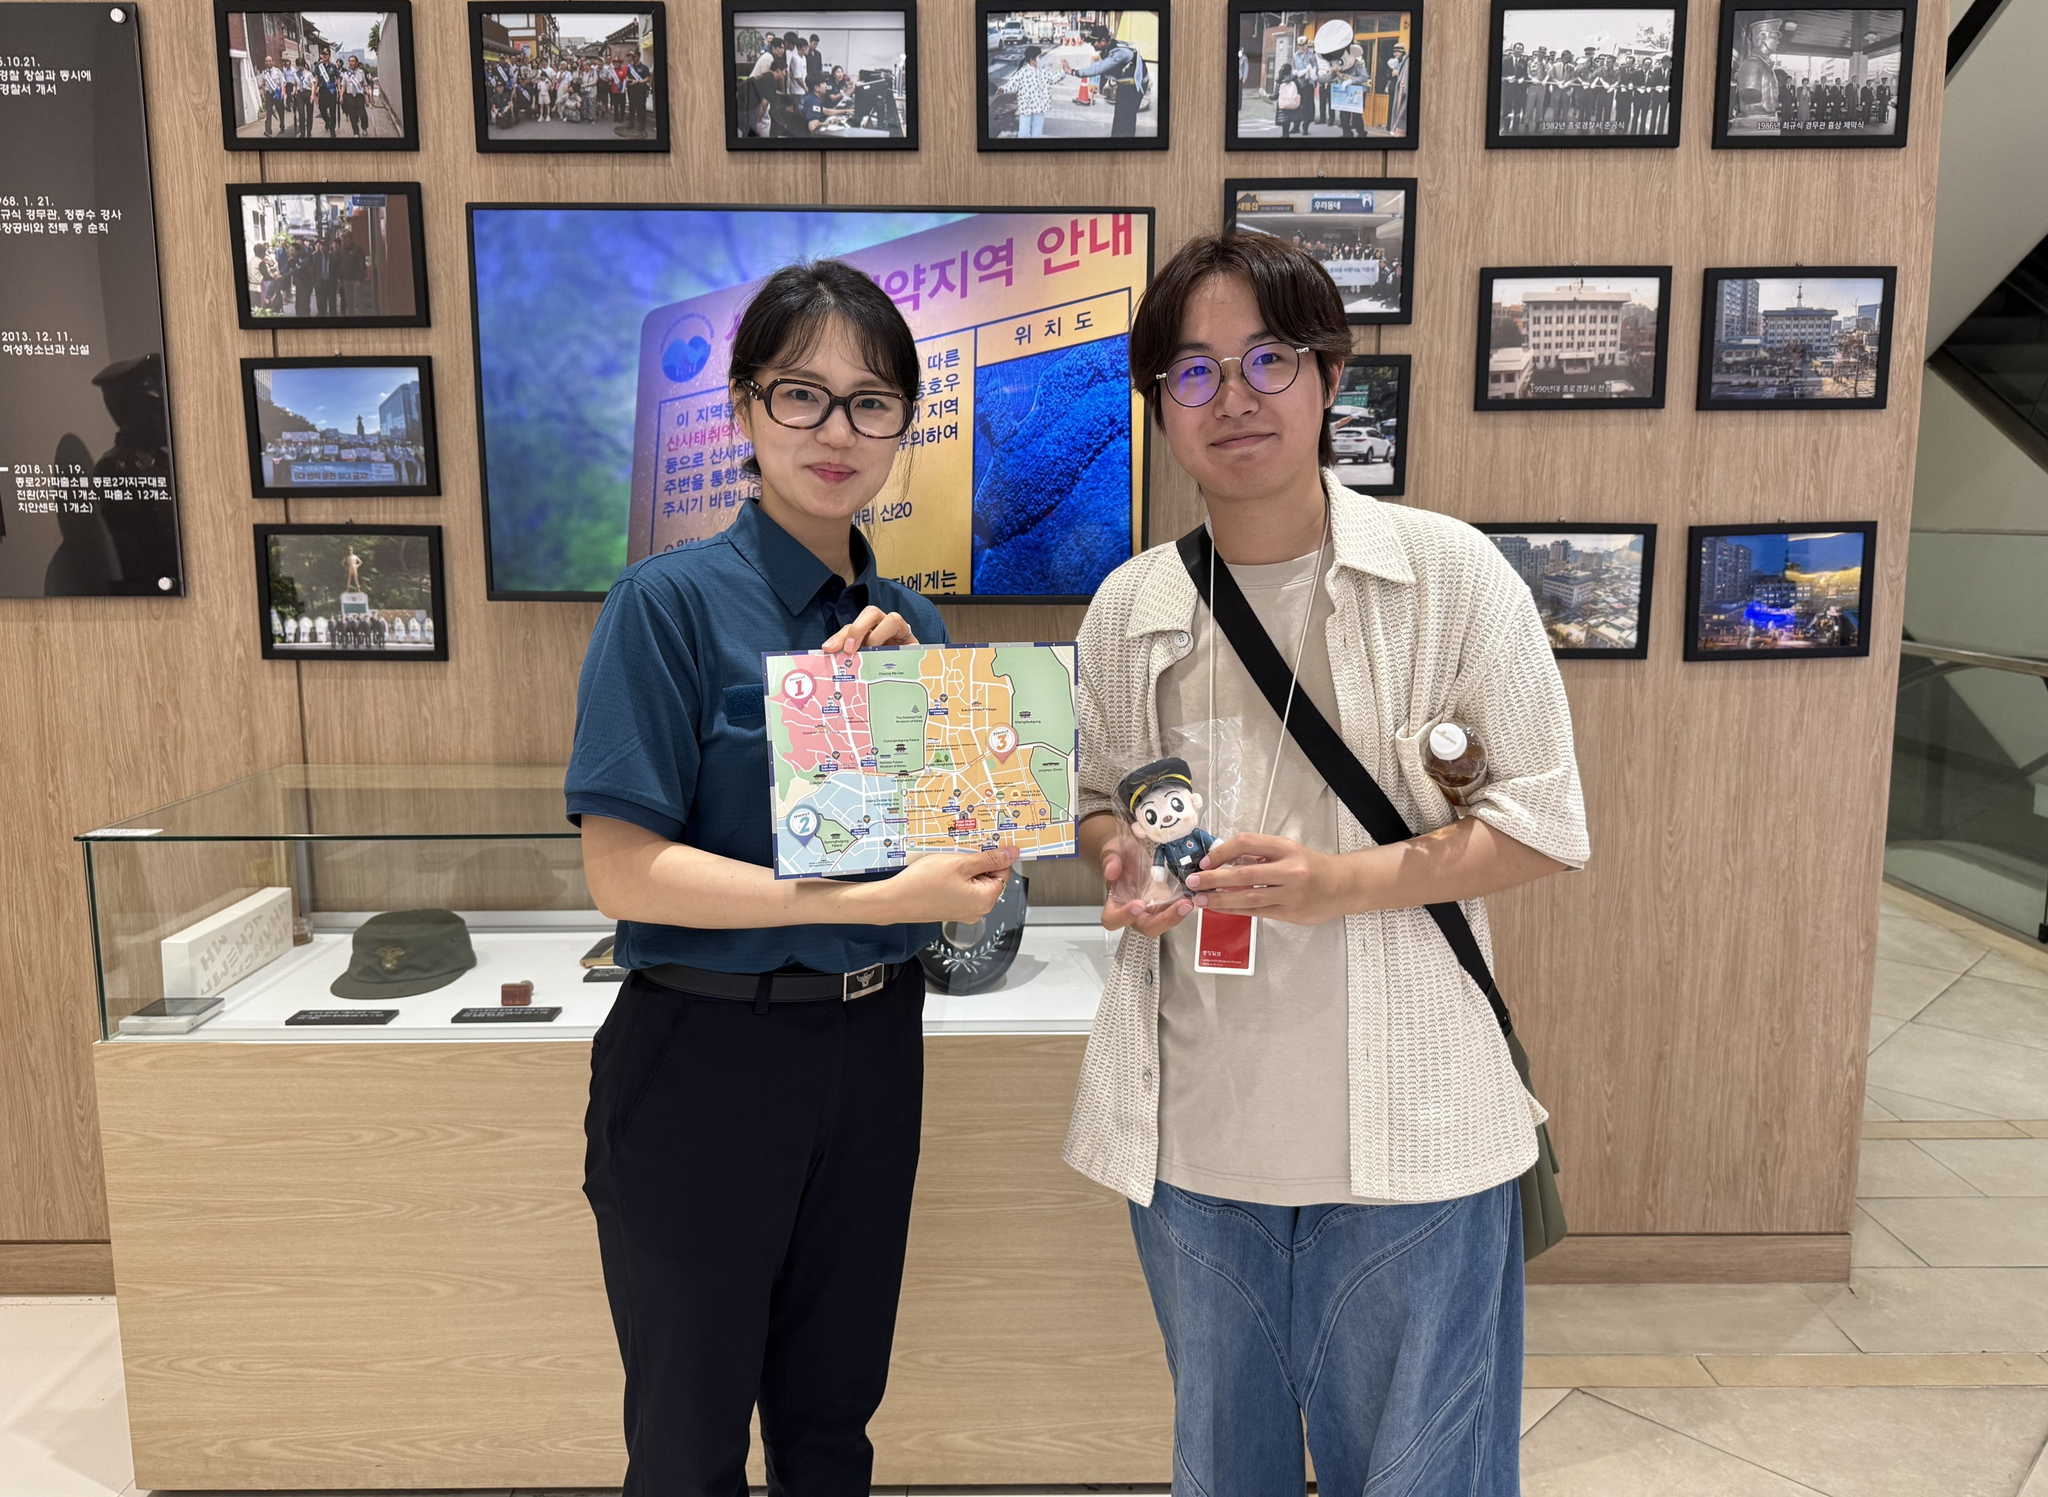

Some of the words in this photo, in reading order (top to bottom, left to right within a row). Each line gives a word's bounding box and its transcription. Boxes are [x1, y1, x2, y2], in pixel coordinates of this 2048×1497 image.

[24, 70, 56, 82] 창설과
[60, 70, 92, 82] 동시에
[36, 84, 57, 95] 개서
[1542, 121, 1565, 130] 1982년
[1568, 121, 1602, 130] 종로경찰서
[1604, 121, 1625, 129] 준공식
[1758, 122, 1780, 130] 1986년
[1782, 122, 1803, 130] 최규식
[1806, 122, 1826, 130] 경무관
[1844, 121, 1864, 129] 제막식
[0, 196, 19, 206] 68.
[24, 196, 33, 206] 1.
[38, 196, 54, 206] 21.
[1314, 201, 1341, 210] 우리동네
[1, 209, 21, 220] 규식
[26, 209, 60, 221] 경무관,
[65, 209, 96, 221] 정종수
[101, 209, 122, 221] 경사
[0, 222, 44, 234] 장공비와
[48, 222, 69, 234] 전투
[73, 222, 83, 234] 중
[88, 222, 108, 234] 순직
[875, 237, 1014, 311] 약지역
[1037, 214, 1132, 276] 안내
[1014, 324, 1031, 346] 위
[1044, 317, 1062, 337] 치
[1074, 311, 1093, 331] 도
[2, 332, 31, 342] 2013.
[36, 332, 52, 342] 12.
[57, 332, 73, 342] 11.
[2, 344, 65, 356] 여성청소년과
[69, 344, 90, 356] 신설
[927, 348, 960, 371] 따른
[1531, 384, 1560, 393] 1990년대
[1562, 385, 1596, 393] 종로경찰서
[927, 396, 958, 419] 지역
[676, 410, 689, 428] 이
[710, 442, 756, 465] 산사태
[14, 465, 44, 474] 2018.
[49, 465, 65, 474] 11.
[69, 465, 85, 474] 19.
[16, 477, 89, 488] 종로2가파출소를
[93, 477, 167, 488] 종로2가지구대로
[664, 473, 705, 497] 주변을
[16, 490, 68, 501] 전환(지구대
[73, 490, 101, 501] 1개소,
[104, 490, 133, 501] 파출소
[138, 490, 172, 501] 12개소,
[18, 502, 59, 513] 치안센터
[64, 502, 93, 513] 1개소)
[662, 496, 703, 518] 주시기
[880, 502, 913, 523] 산20
[795, 680, 804, 697] 1
[996, 734, 1008, 751] 3
[799, 817, 810, 834] 2
